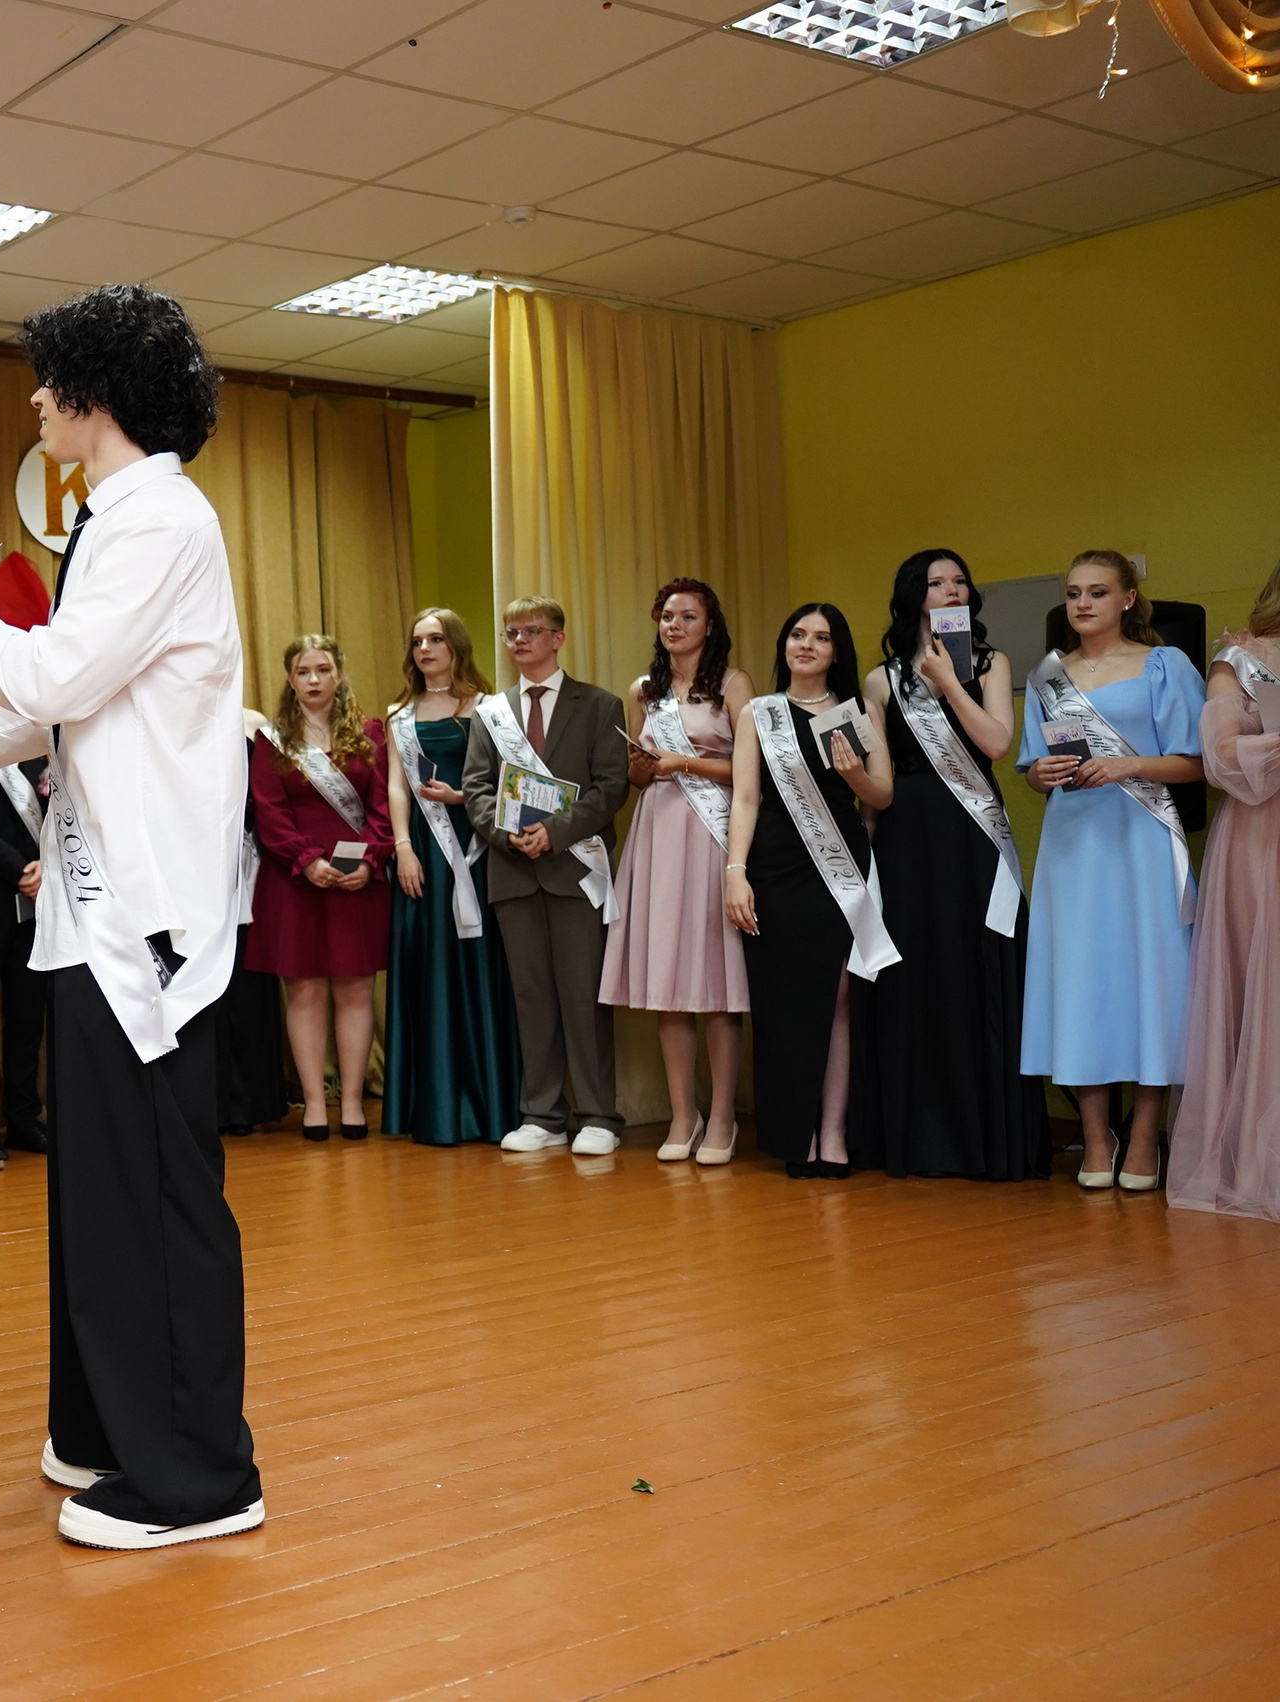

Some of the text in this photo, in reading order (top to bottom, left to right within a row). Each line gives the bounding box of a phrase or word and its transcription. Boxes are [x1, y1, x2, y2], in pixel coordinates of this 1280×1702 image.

[770, 733, 861, 892] Выпускница 2024
[908, 696, 976, 791] Выпускница
[972, 793, 1013, 841] 2024
[54, 806, 104, 907] 2024
